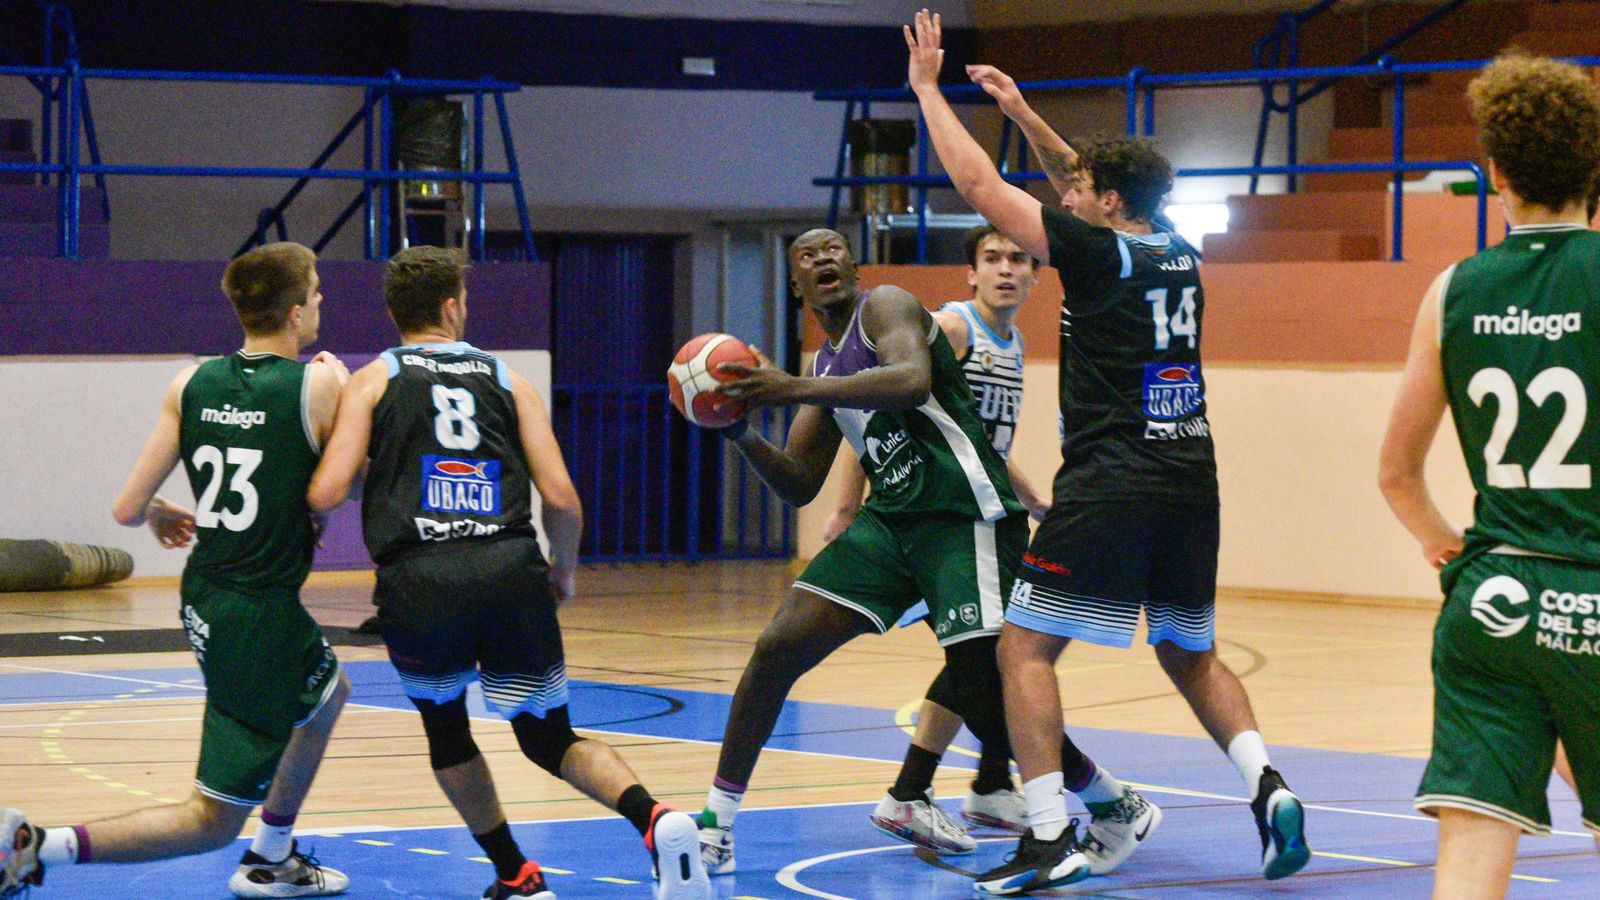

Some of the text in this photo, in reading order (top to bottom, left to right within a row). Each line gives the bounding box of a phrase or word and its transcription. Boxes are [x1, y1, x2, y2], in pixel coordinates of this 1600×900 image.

[1144, 286, 1197, 350] 14
[1473, 305, 1581, 341] málaga
[201, 404, 266, 430] málaga
[432, 384, 481, 451] 8
[1467, 366, 1592, 489] 22
[192, 444, 264, 532] 23
[428, 480, 494, 512] UBAGO
[1538, 611, 1600, 636] DEL S
